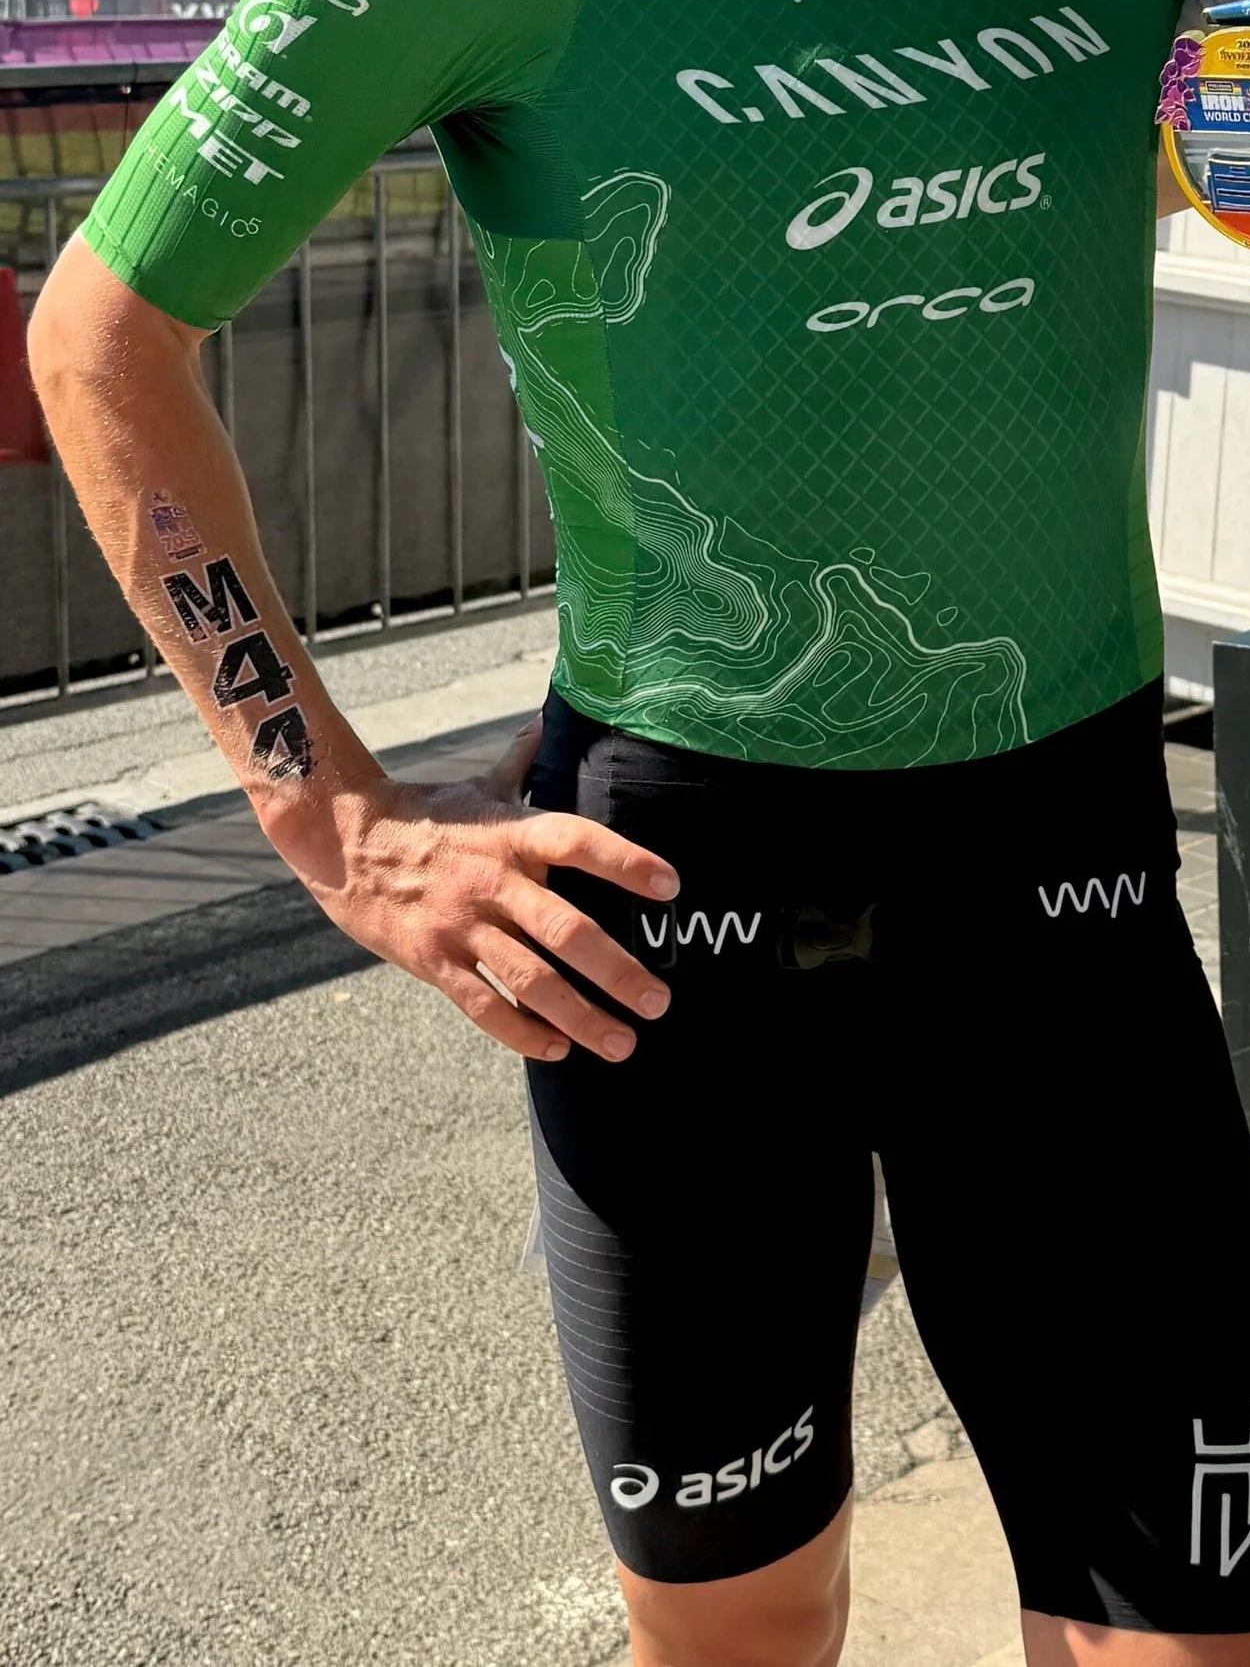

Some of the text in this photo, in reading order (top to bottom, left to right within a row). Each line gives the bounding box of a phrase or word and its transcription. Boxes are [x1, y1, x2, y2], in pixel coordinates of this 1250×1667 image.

[676, 6, 1111, 124] CANYON
[169, 85, 285, 185] MET
[1204, 112, 1240, 122] WORLD
[806, 277, 1035, 332] orca
